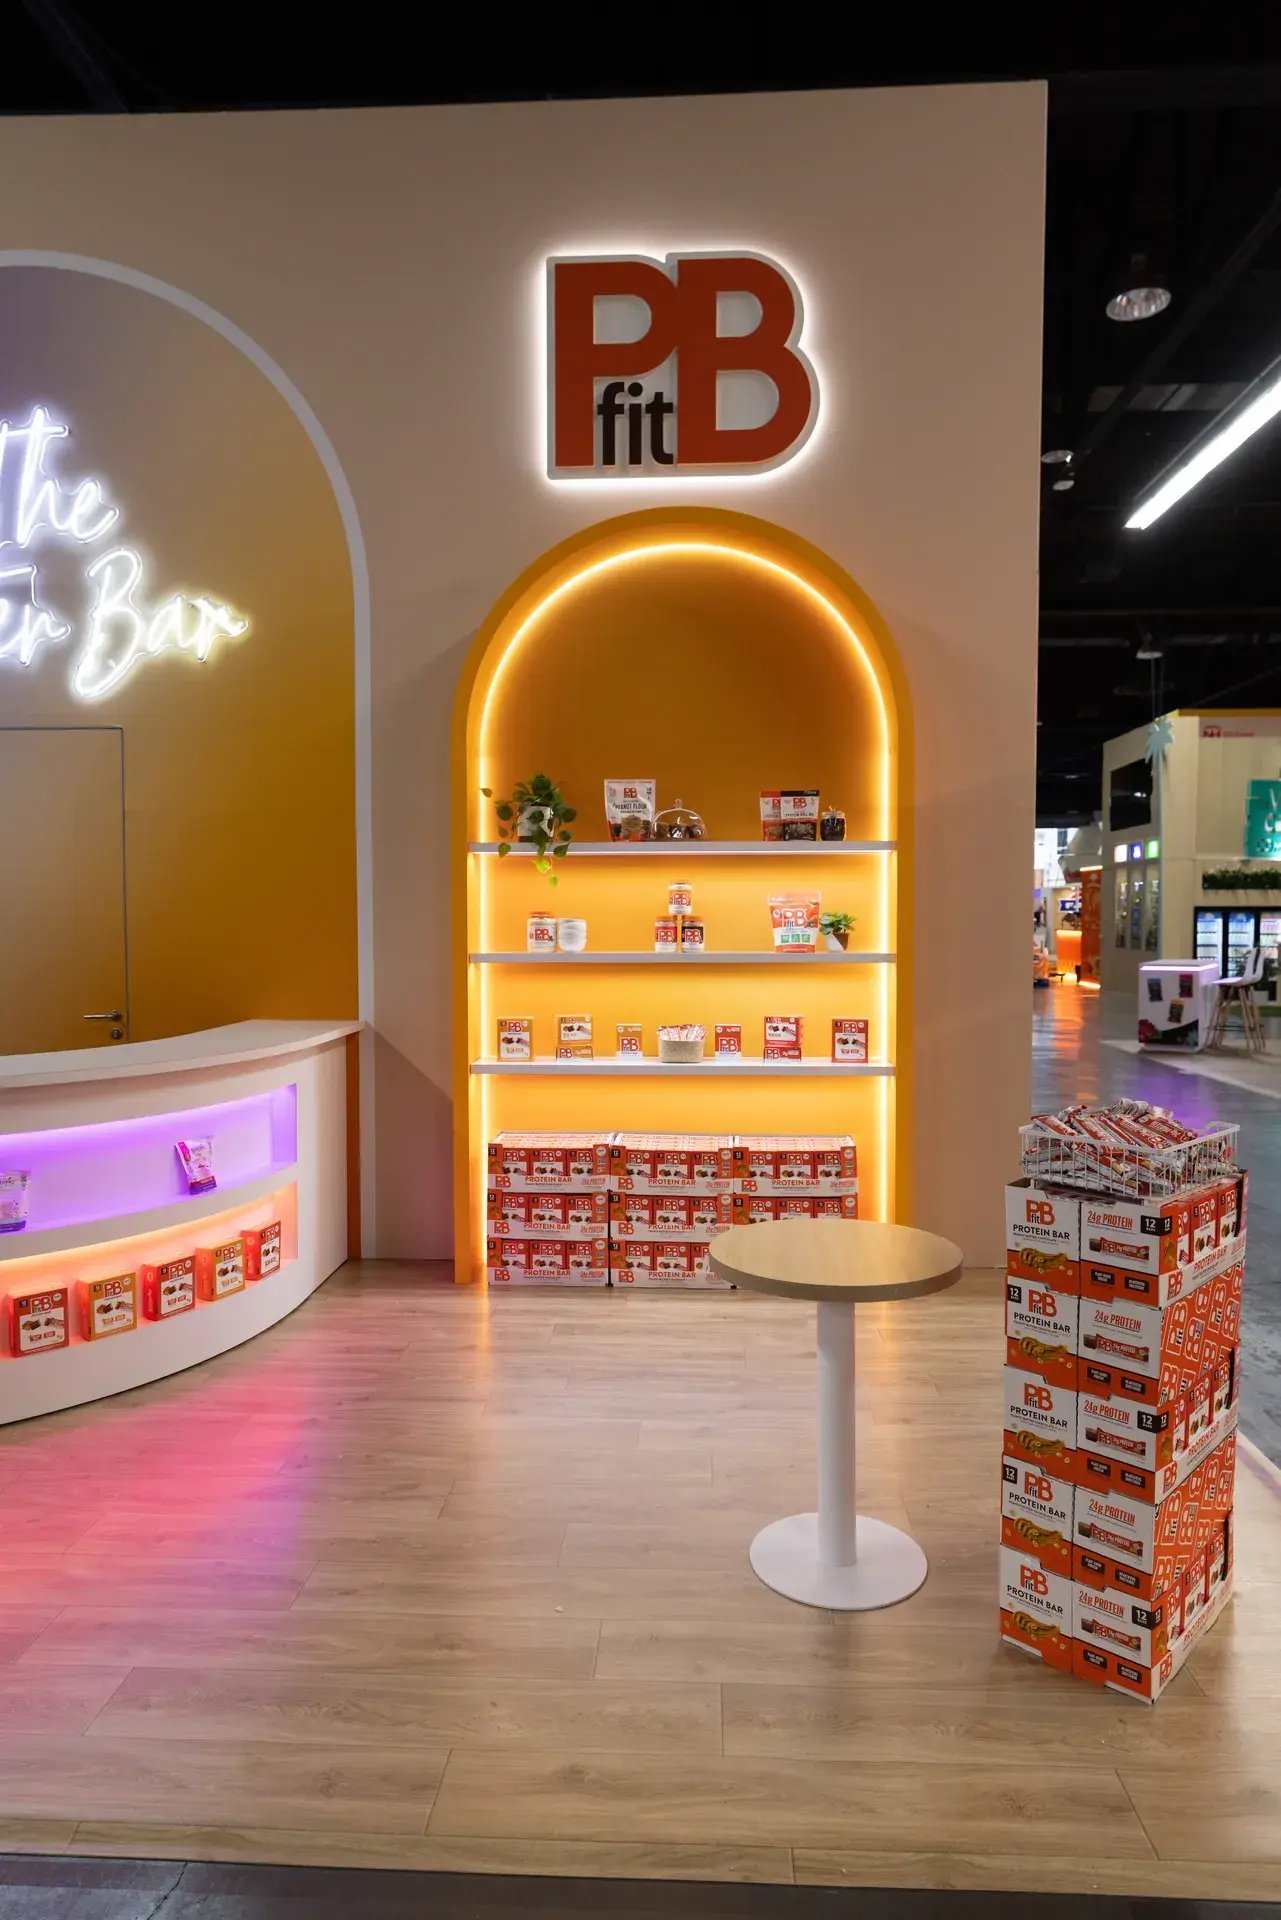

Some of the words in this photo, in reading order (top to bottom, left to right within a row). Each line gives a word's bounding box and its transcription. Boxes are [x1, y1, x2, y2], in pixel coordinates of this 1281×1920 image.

[597, 382, 674, 465] fit
[8, 405, 119, 547] the
[71, 547, 249, 697] Bar
[1031, 1214, 1040, 1224] fit
[1087, 1211, 1101, 1225] 24g
[1103, 1214, 1133, 1229] PROTEIN
[1145, 1218, 1156, 1228] 12
[1013, 1224, 1050, 1237] PROTEIN
[1052, 1231, 1070, 1240] BAR
[1009, 1287, 1019, 1297] 12
[1033, 1304, 1042, 1315] fit
[1013, 1312, 1051, 1328] PROTEIN
[1052, 1322, 1071, 1333] BAR
[1094, 1309, 1109, 1325] 24g
[1110, 1314, 1141, 1331] PROTEIN
[1029, 1397, 1038, 1409] fit
[1084, 1400, 1098, 1415] 24g
[1099, 1404, 1130, 1422] PROTEIN
[1010, 1405, 1048, 1422] PROTEIN
[1050, 1417, 1068, 1428] BAR
[1142, 1414, 1153, 1425] 12
[1005, 1467, 1015, 1478] 12
[1029, 1486, 1038, 1498] fit
[1009, 1492, 1047, 1512] PROTEIN
[1048, 1507, 1066, 1520] BAR
[1088, 1499, 1103, 1515] 24g
[1105, 1504, 1136, 1525] PROTEIN
[1025, 1580, 1034, 1592] fit
[1007, 1585, 1044, 1606] PROTEIN
[1046, 1601, 1063, 1614] BAR
[1079, 1591, 1093, 1606] 24g
[1095, 1596, 1125, 1616] PROTEIN
[1136, 1609, 1147, 1621] 12
